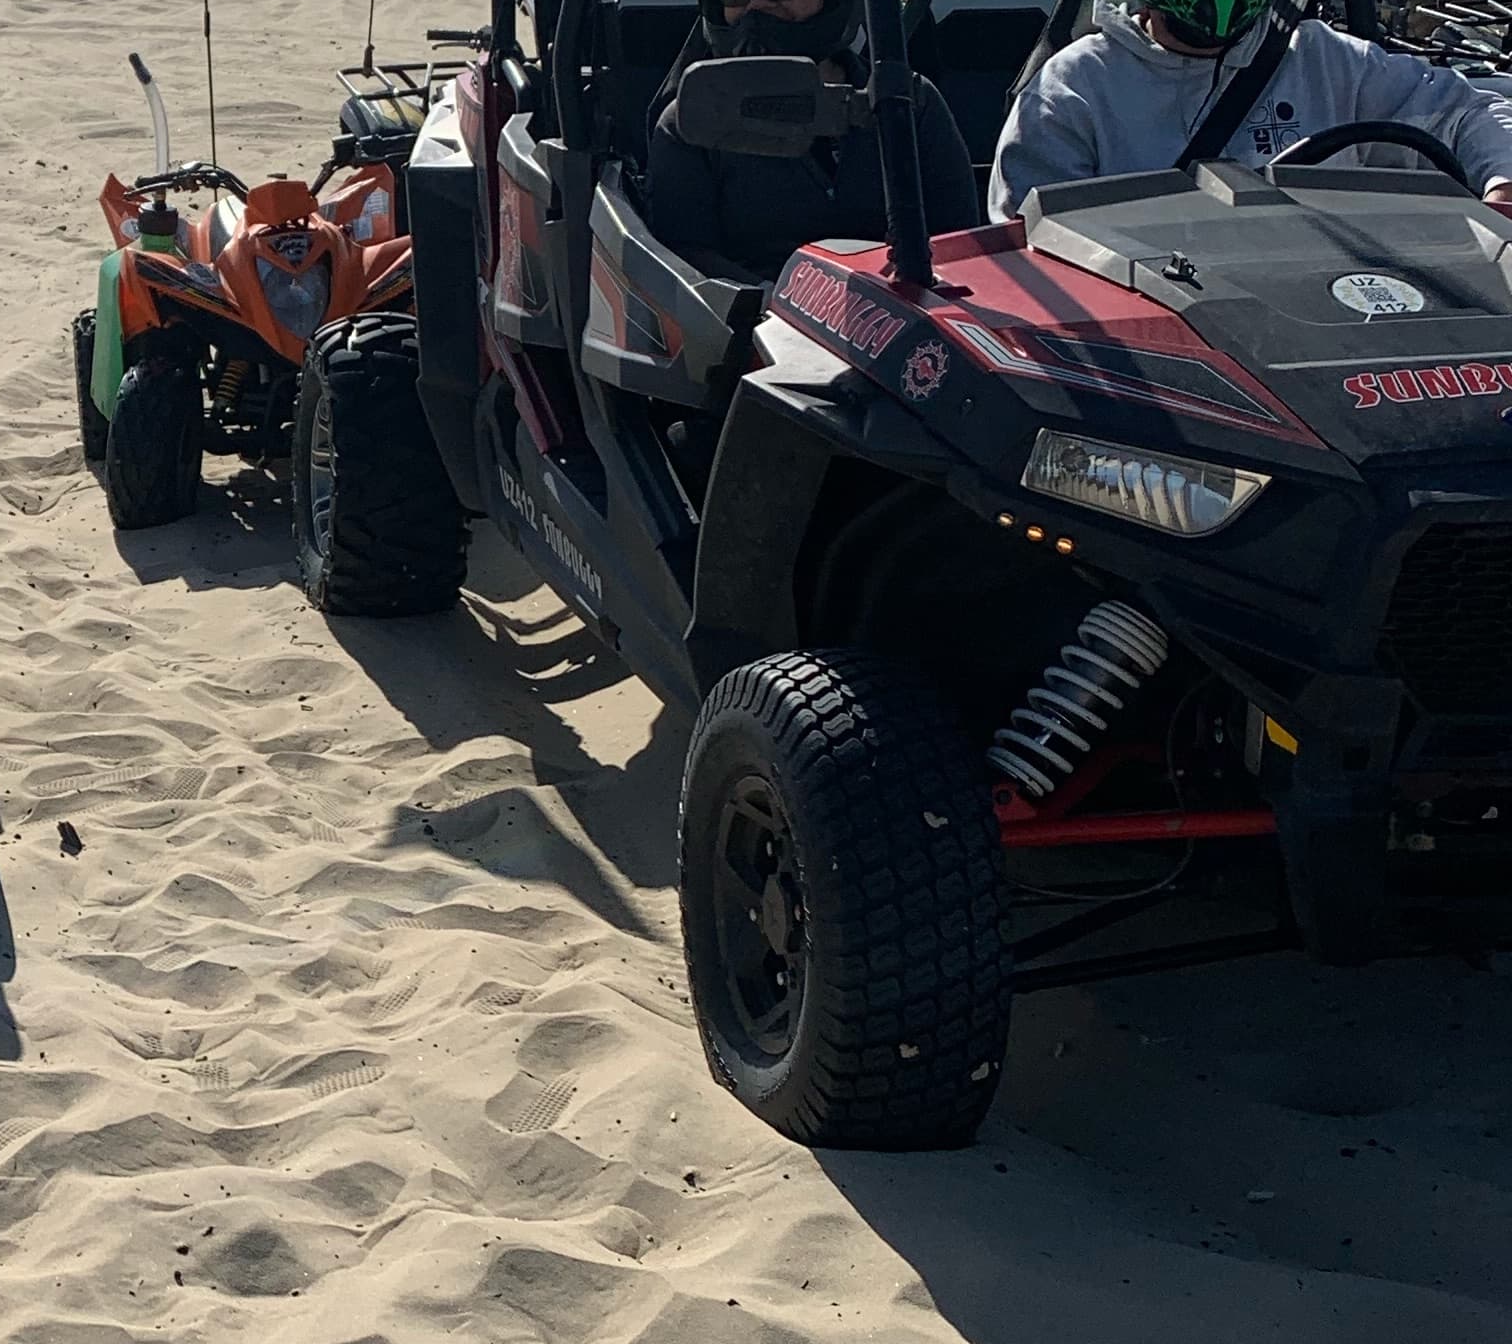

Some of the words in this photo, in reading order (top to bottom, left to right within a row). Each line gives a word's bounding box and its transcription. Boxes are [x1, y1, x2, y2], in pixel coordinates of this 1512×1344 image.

[1349, 277, 1382, 287] UZ
[779, 260, 907, 359] SUNBUGGY
[1374, 303, 1411, 313] 412
[499, 465, 538, 532] UZ412
